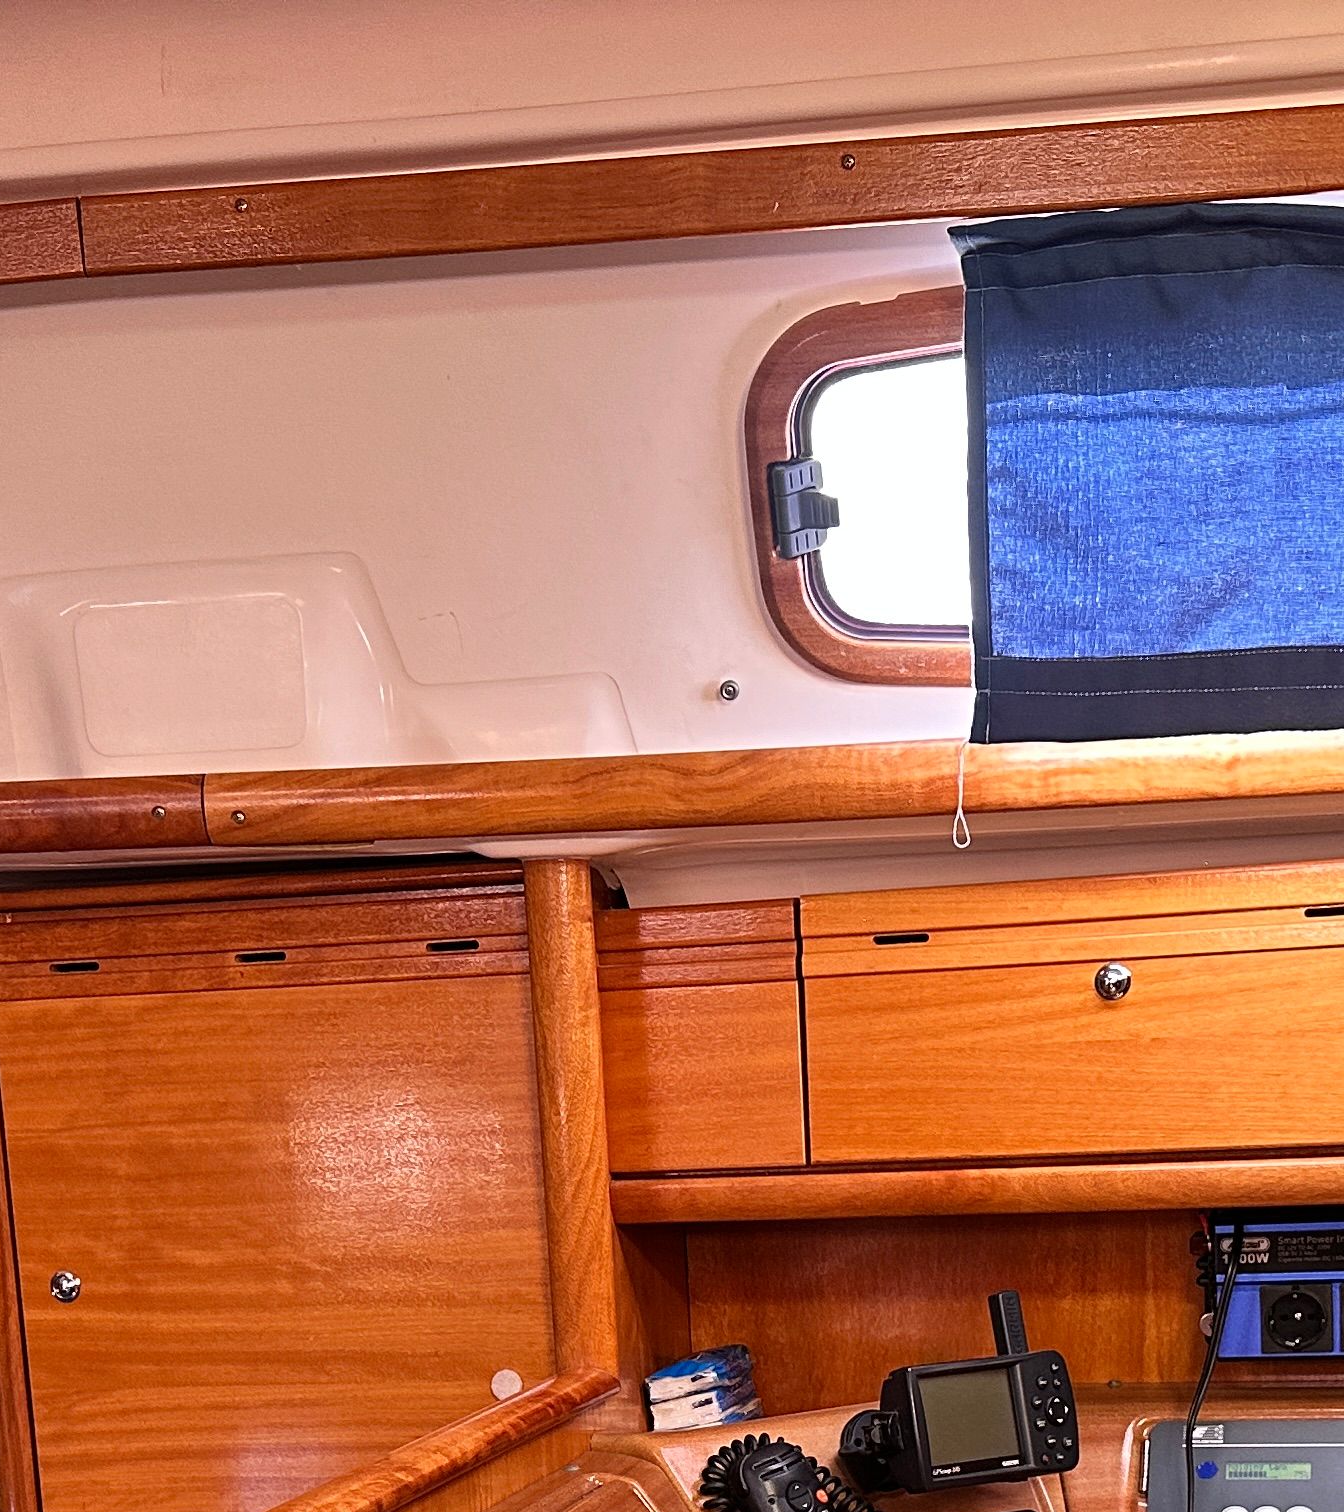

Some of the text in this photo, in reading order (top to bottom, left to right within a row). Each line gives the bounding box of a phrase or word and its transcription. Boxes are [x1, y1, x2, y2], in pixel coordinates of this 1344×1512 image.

[1278, 1236, 1305, 1245] Smart
[1307, 1236, 1335, 1244] Power
[1222, 1253, 1269, 1264] 100W
